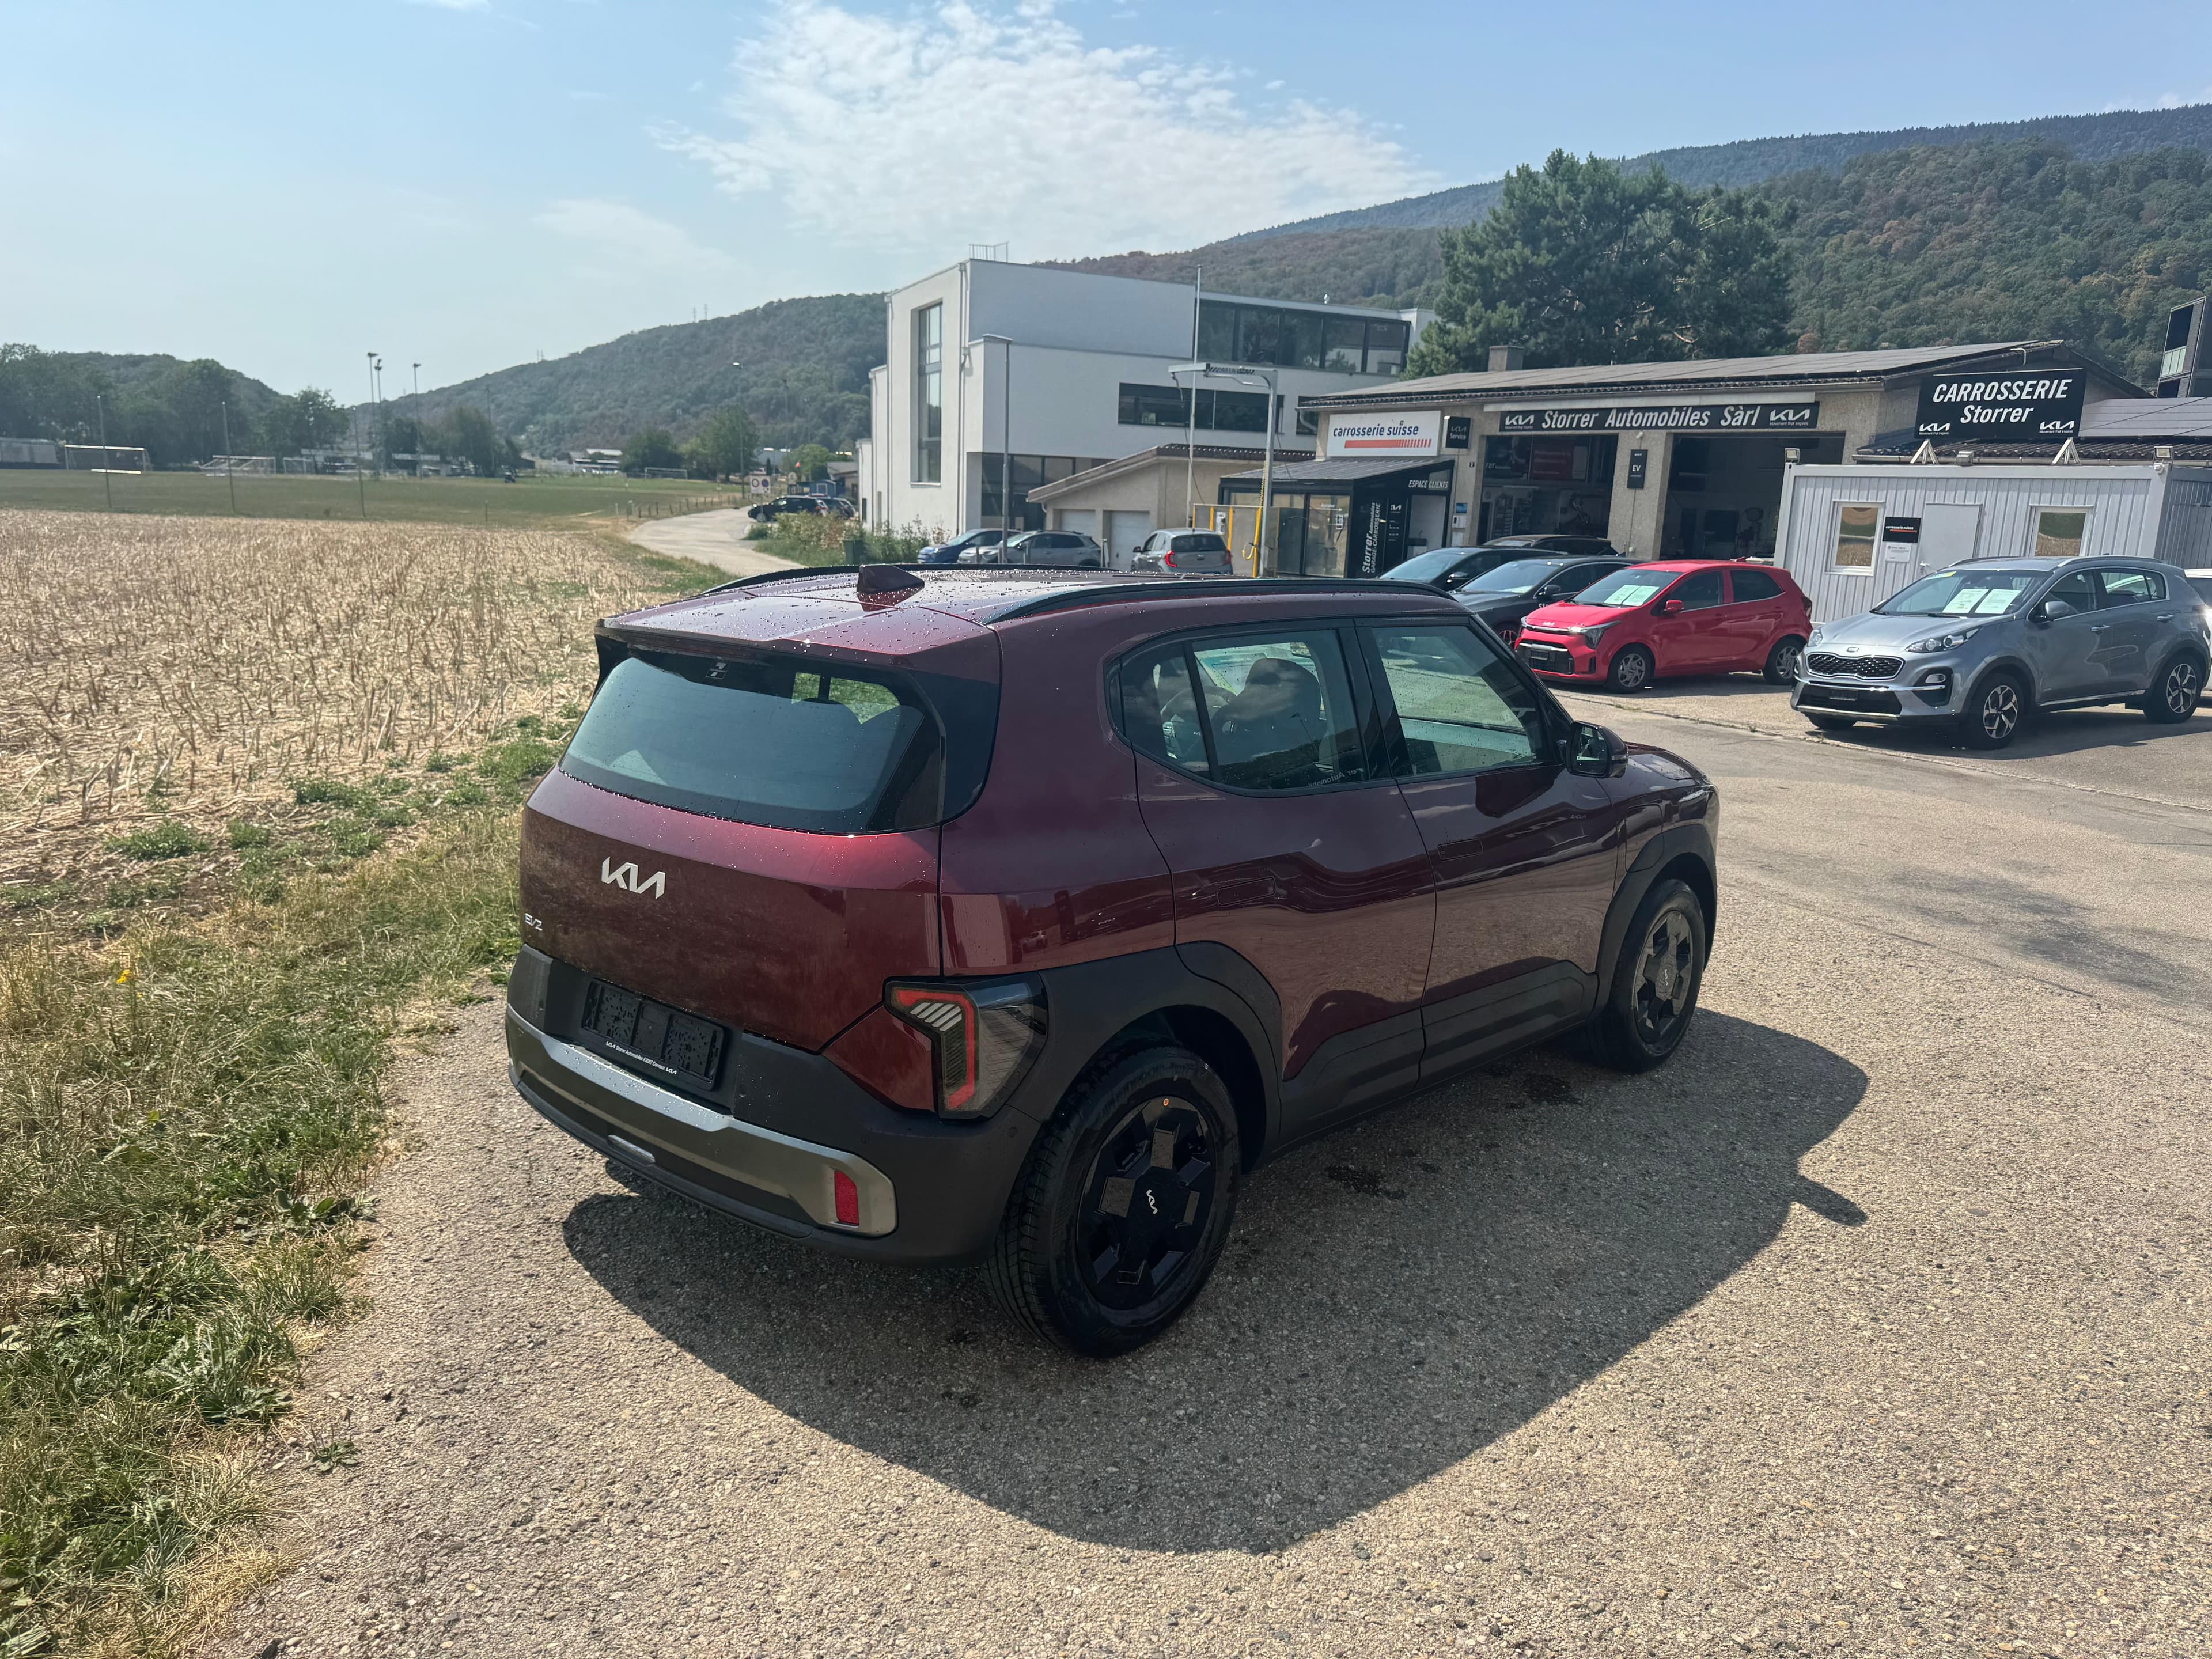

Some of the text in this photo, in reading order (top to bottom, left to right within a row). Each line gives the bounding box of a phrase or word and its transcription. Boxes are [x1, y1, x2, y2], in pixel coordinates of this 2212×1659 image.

[1933, 379, 2073, 402] CARROSSERIE
[1505, 415, 1535, 425] KIA
[1542, 404, 1761, 429] Storrer Automobiles Sàrl
[1770, 409, 1810, 421] KIA
[1960, 404, 2034, 423] Storrer
[1333, 421, 1419, 437] carrosserie suisse
[1919, 423, 1950, 432] KIA
[2040, 421, 2074, 430] KIA
[1408, 480, 1449, 489] ESPACE CLIENTS
[1362, 533, 1373, 573] Storrer
[602, 857, 666, 899] KIA
[525, 912, 543, 931] EV2
